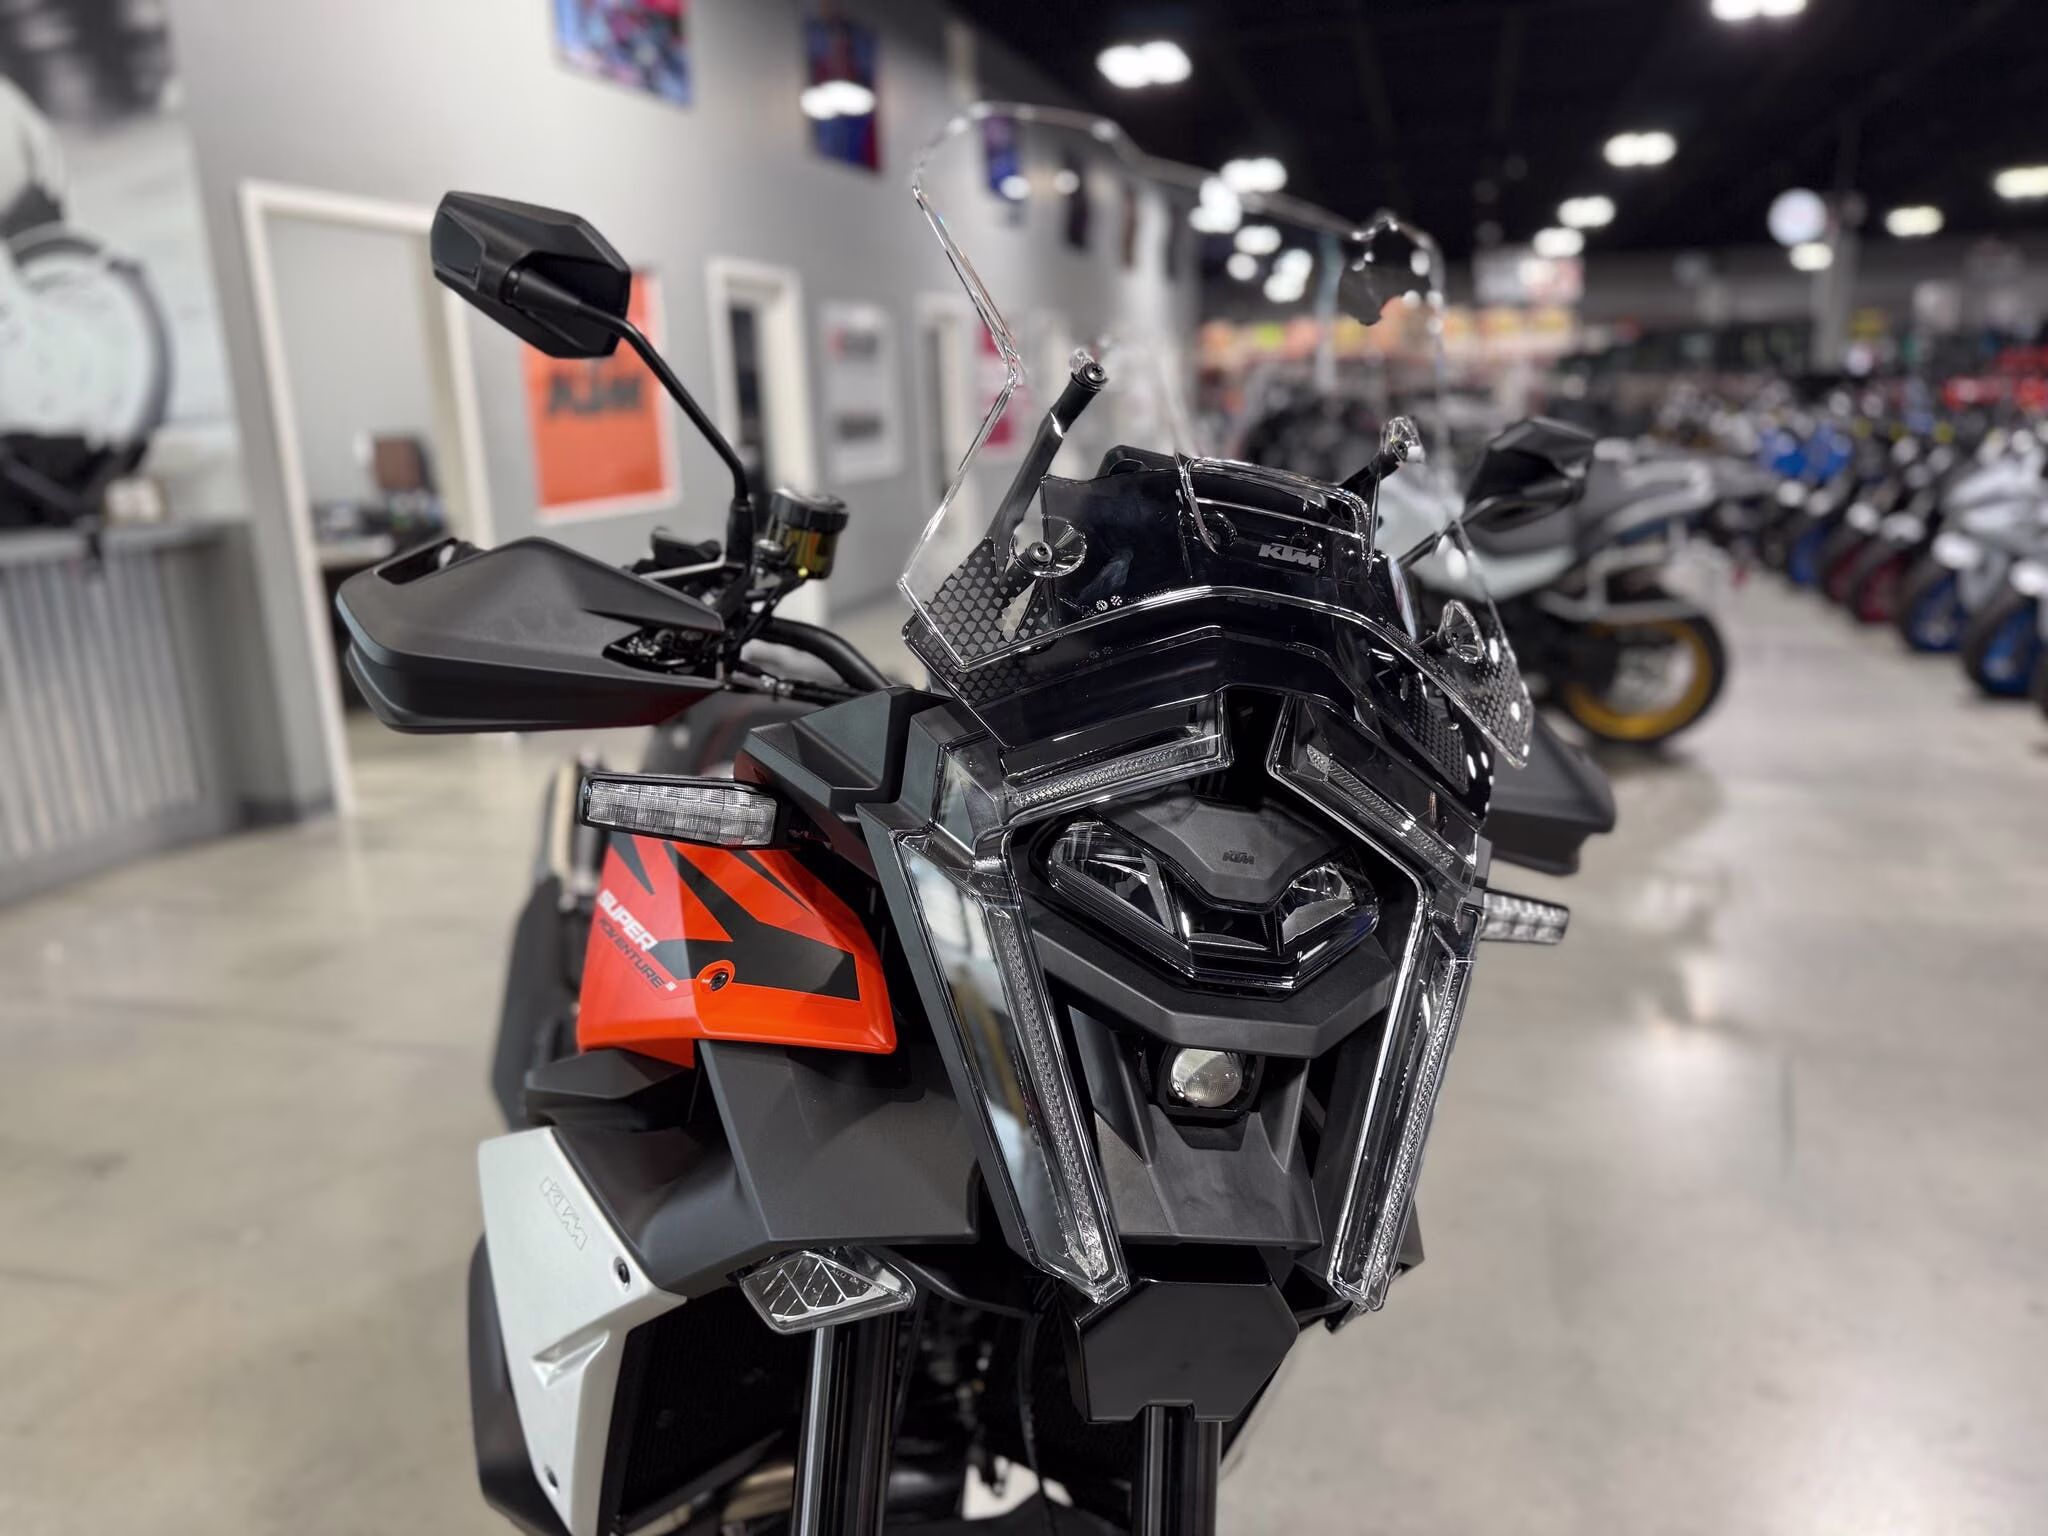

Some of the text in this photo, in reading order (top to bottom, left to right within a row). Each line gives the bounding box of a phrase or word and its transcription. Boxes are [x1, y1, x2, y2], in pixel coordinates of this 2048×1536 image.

[1258, 542, 1320, 569] KTM
[1222, 849, 1255, 865] KTM
[597, 888, 659, 952] SUPER
[599, 917, 665, 989] ADVENTURE
[540, 1175, 588, 1251] KTM
